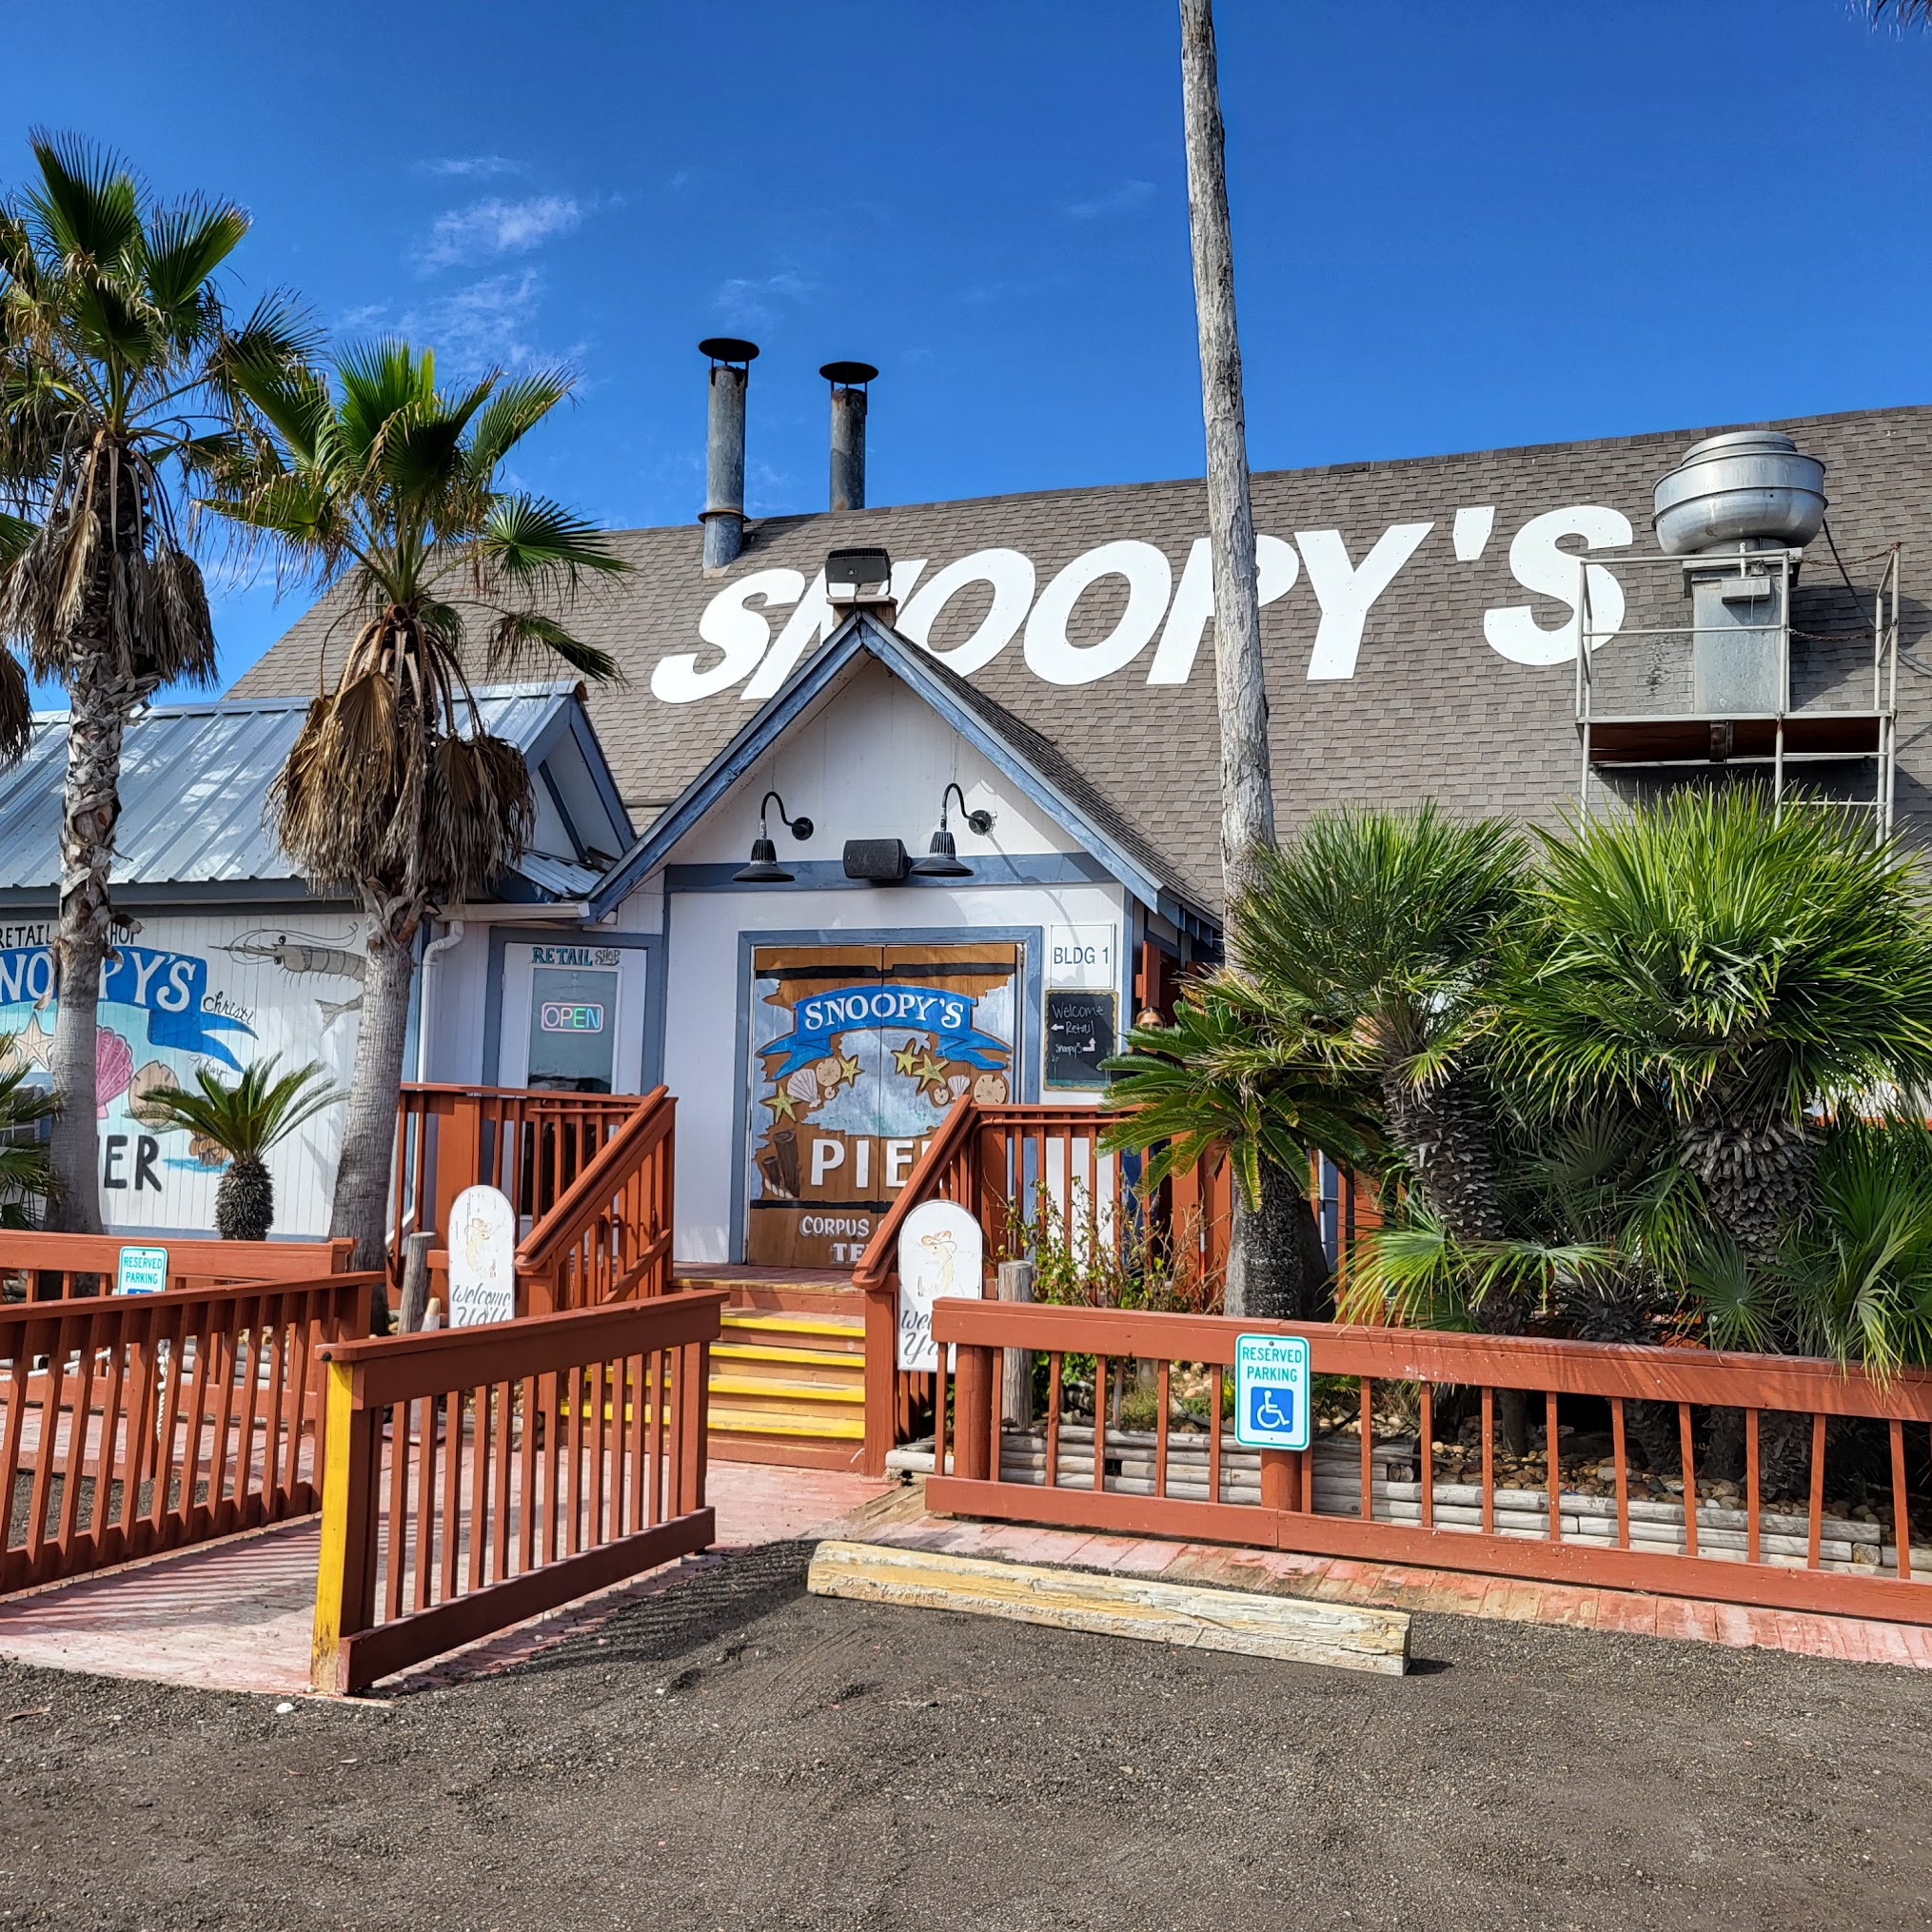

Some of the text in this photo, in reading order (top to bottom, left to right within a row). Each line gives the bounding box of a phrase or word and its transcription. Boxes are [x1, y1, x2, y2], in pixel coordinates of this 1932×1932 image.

[650, 505, 1633, 703] SNOOPY'S
[109, 920, 135, 945] HO
[532, 947, 621, 966] RETAIL SHOP
[1054, 946, 1109, 964] BLDG 1
[0, 951, 197, 1012] NOPY'S
[544, 1007, 601, 1029] OPEN
[804, 993, 965, 1031] SNOOPY'S
[1052, 1001, 1105, 1019] Welcome
[1065, 1019, 1094, 1035] Retail
[98, 1134, 163, 1193] ER
[811, 1138, 942, 1189] PIE
[800, 1214, 870, 1236] CORPUS
[124, 1256, 163, 1269] RESERVED
[126, 1272, 158, 1284] PARKING
[451, 1282, 511, 1307] Welcome
[1242, 1347, 1302, 1363] RESERVED
[1247, 1366, 1298, 1382] PARKING
